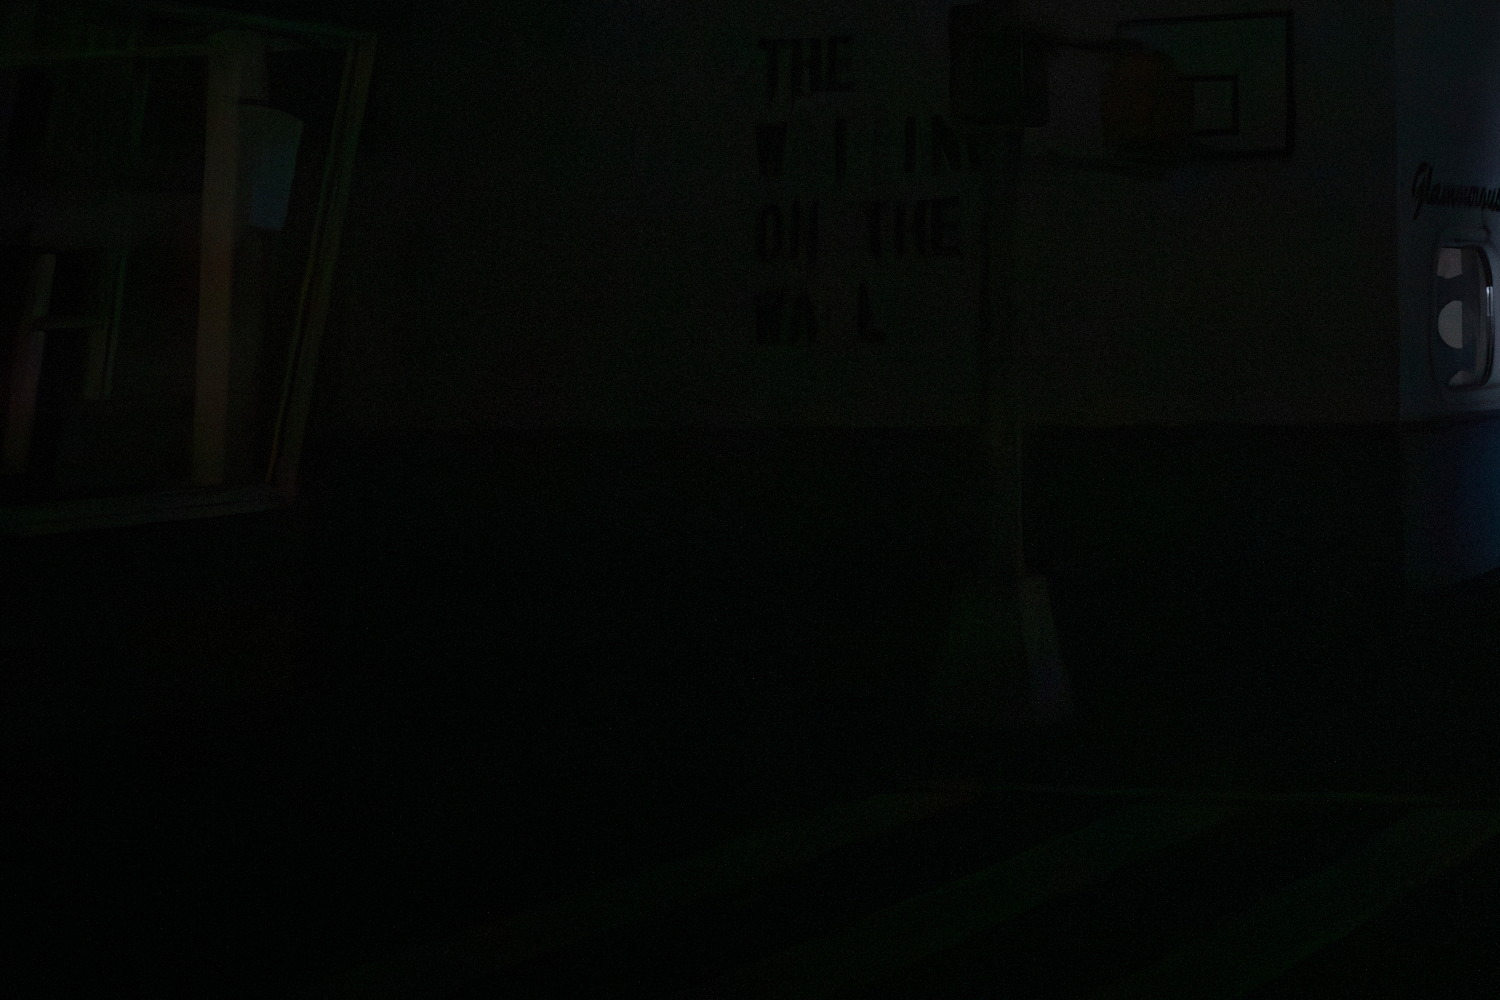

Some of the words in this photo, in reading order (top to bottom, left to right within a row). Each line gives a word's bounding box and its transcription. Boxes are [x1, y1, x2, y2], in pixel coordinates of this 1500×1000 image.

[756, 36, 854, 98] THE
[754, 196, 819, 263] ON
[856, 196, 962, 258] THE
[754, 281, 887, 346] WAL
